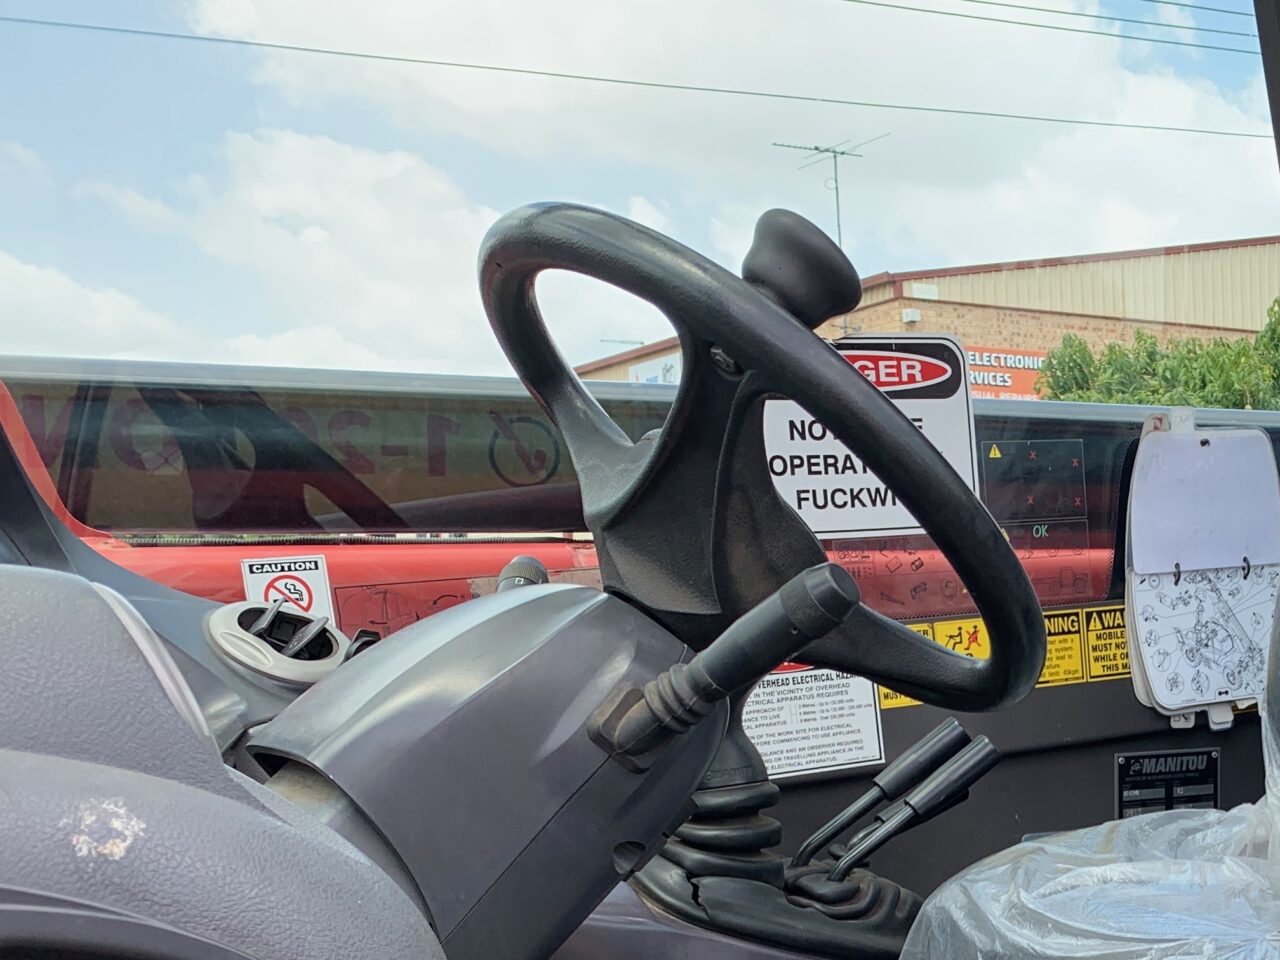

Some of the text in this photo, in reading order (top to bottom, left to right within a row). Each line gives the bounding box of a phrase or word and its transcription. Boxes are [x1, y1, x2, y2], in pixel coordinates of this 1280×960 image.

[860, 360, 923, 383] GER
[969, 371, 1012, 387] RVICES
[788, 419, 837, 441] NO
[1033, 525, 1048, 537] OK
[252, 561, 316, 573] CAUTION
[1045, 616, 1079, 633] NING
[1096, 631, 1125, 641] MOBILE
[1091, 641, 1127, 653] MUST NO
[1093, 653, 1117, 663] WHILE
[1101, 664, 1119, 673] THIS
[759, 677, 791, 689] ERHEAD
[792, 672, 834, 685] ELECTRICAL
[777, 688, 803, 696] VICINITY
[816, 682, 850, 691] OVERHEAD
[746, 690, 849, 707] CTRICAL APPARATUS REQUIRES
[745, 707, 776, 715] APPROACH
[755, 720, 787, 728] APPARATUS
[821, 723, 852, 731] ELECTRICAL
[773, 737, 810, 745] COMMENCING
[807, 742, 835, 751] OBSERVER
[837, 738, 863, 746] REQUIRED
[783, 752, 816, 761] TRAVELLING
[818, 748, 846, 756] APPLIANCE
[771, 761, 803, 770] ELECTRICAL
[1142, 754, 1207, 774] MANITOU
